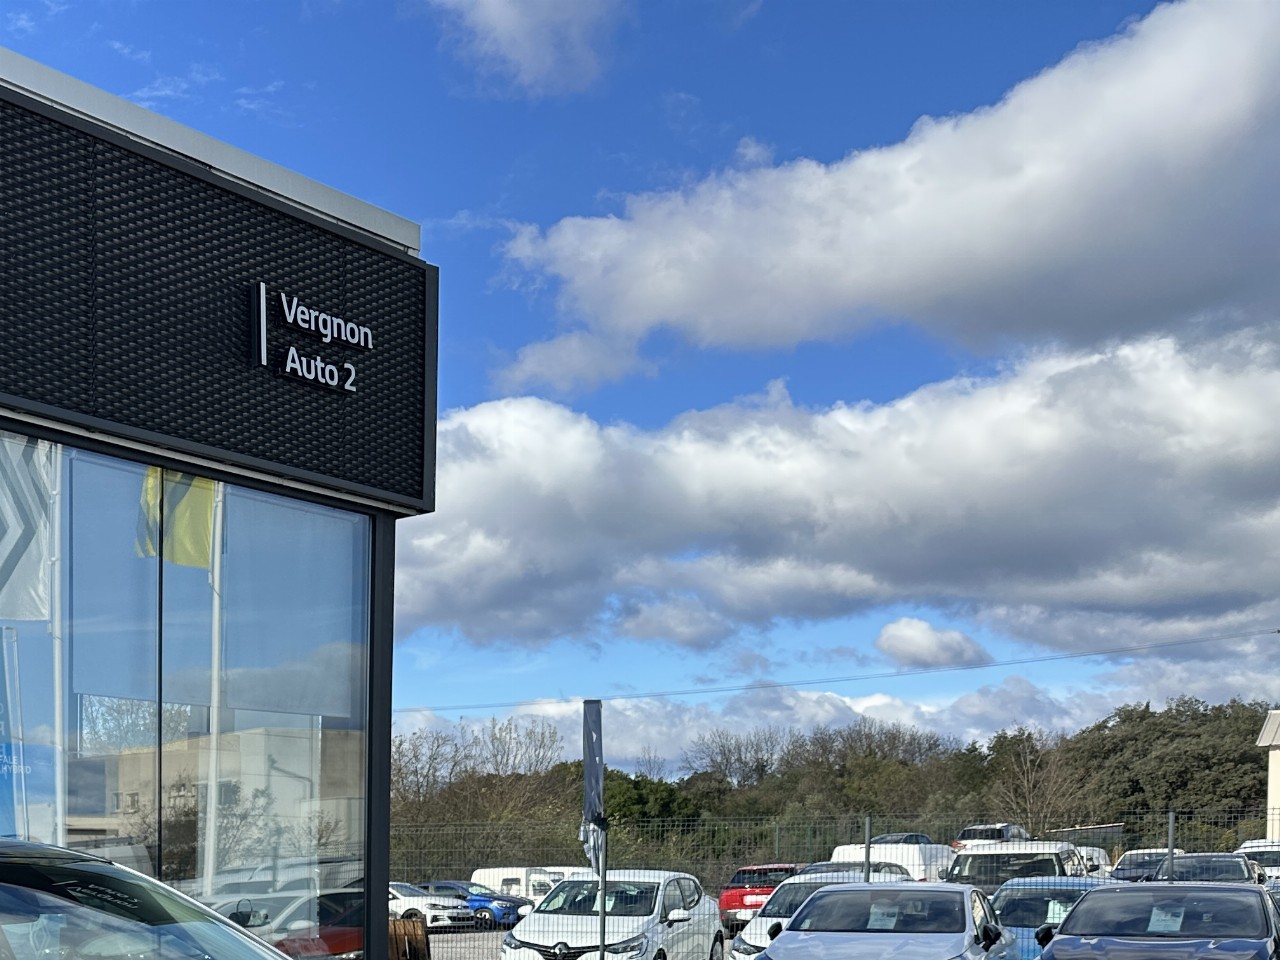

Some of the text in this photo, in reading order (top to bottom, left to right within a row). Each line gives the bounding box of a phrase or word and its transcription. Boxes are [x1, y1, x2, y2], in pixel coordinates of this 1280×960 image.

[281, 292, 373, 349] Vergnon
[286, 346, 357, 392] Auto 2
